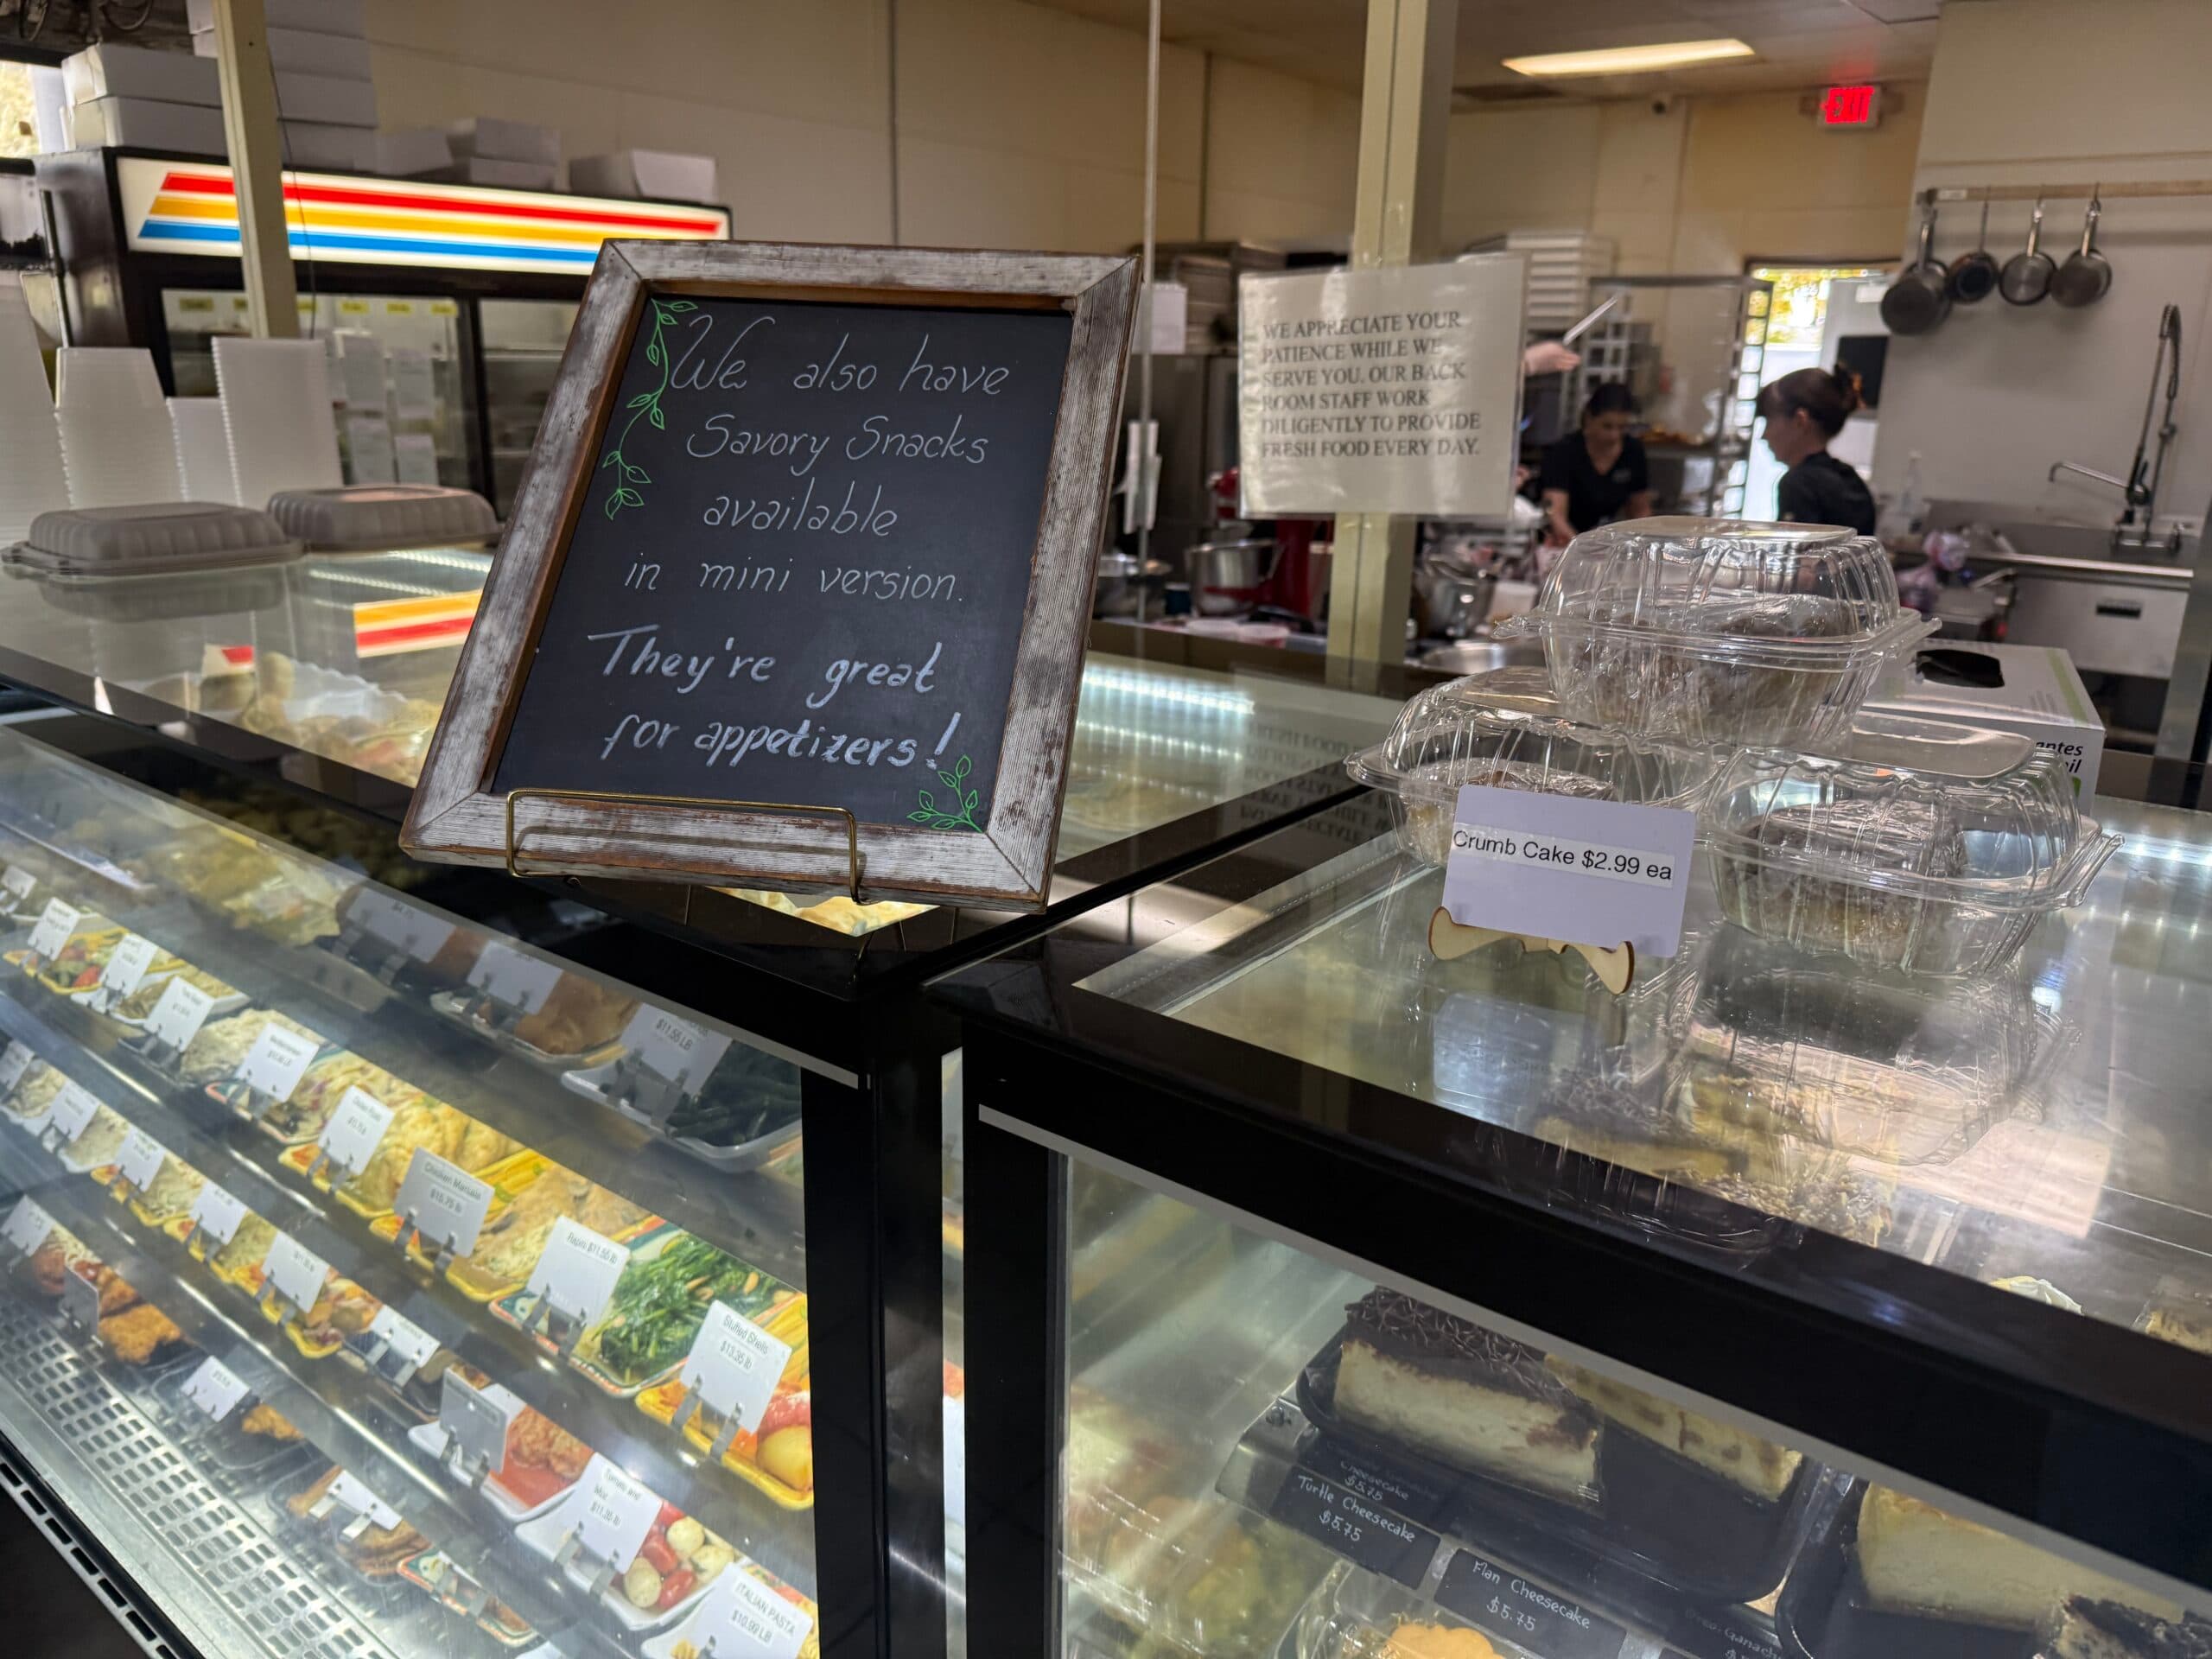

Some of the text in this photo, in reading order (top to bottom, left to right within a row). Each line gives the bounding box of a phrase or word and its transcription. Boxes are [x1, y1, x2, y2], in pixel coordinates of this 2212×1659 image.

[1824, 86, 1874, 124] EXIT
[1262, 310, 1462, 340] WE APPRECIATE YOUR
[671, 315, 1009, 395] We also have
[1262, 337, 1442, 363] PATIENCE WHILE WE
[1262, 361, 1466, 388] SERVE YOU. OUR BACK
[1262, 389, 1431, 411] ROOM STAFF WORK
[1262, 412, 1481, 435] DILIGENTLY TO PROVIDE
[687, 414, 989, 476] Savory Snacks
[1262, 436, 1481, 457] FRESH FOOD EVERY DAY.
[703, 477, 898, 537] available
[625, 552, 963, 602] in mini version.
[588, 624, 943, 709] They're great
[601, 711, 961, 770] for appetizers!
[1452, 830, 1673, 880] Crumb Cake $2.99 ea
[1340, 1460, 1409, 1501] Cheesecake
[1344, 1474, 1383, 1502] $5.75
[1298, 1474, 1416, 1543] Turtle Cheesecake
[1319, 1509, 1363, 1541] $5.75
[734, 1581, 796, 1636] ITALIAN PASTA
[1472, 1560, 1591, 1630] Flan Cheesecake
[1486, 1596, 1536, 1631] $5.75
